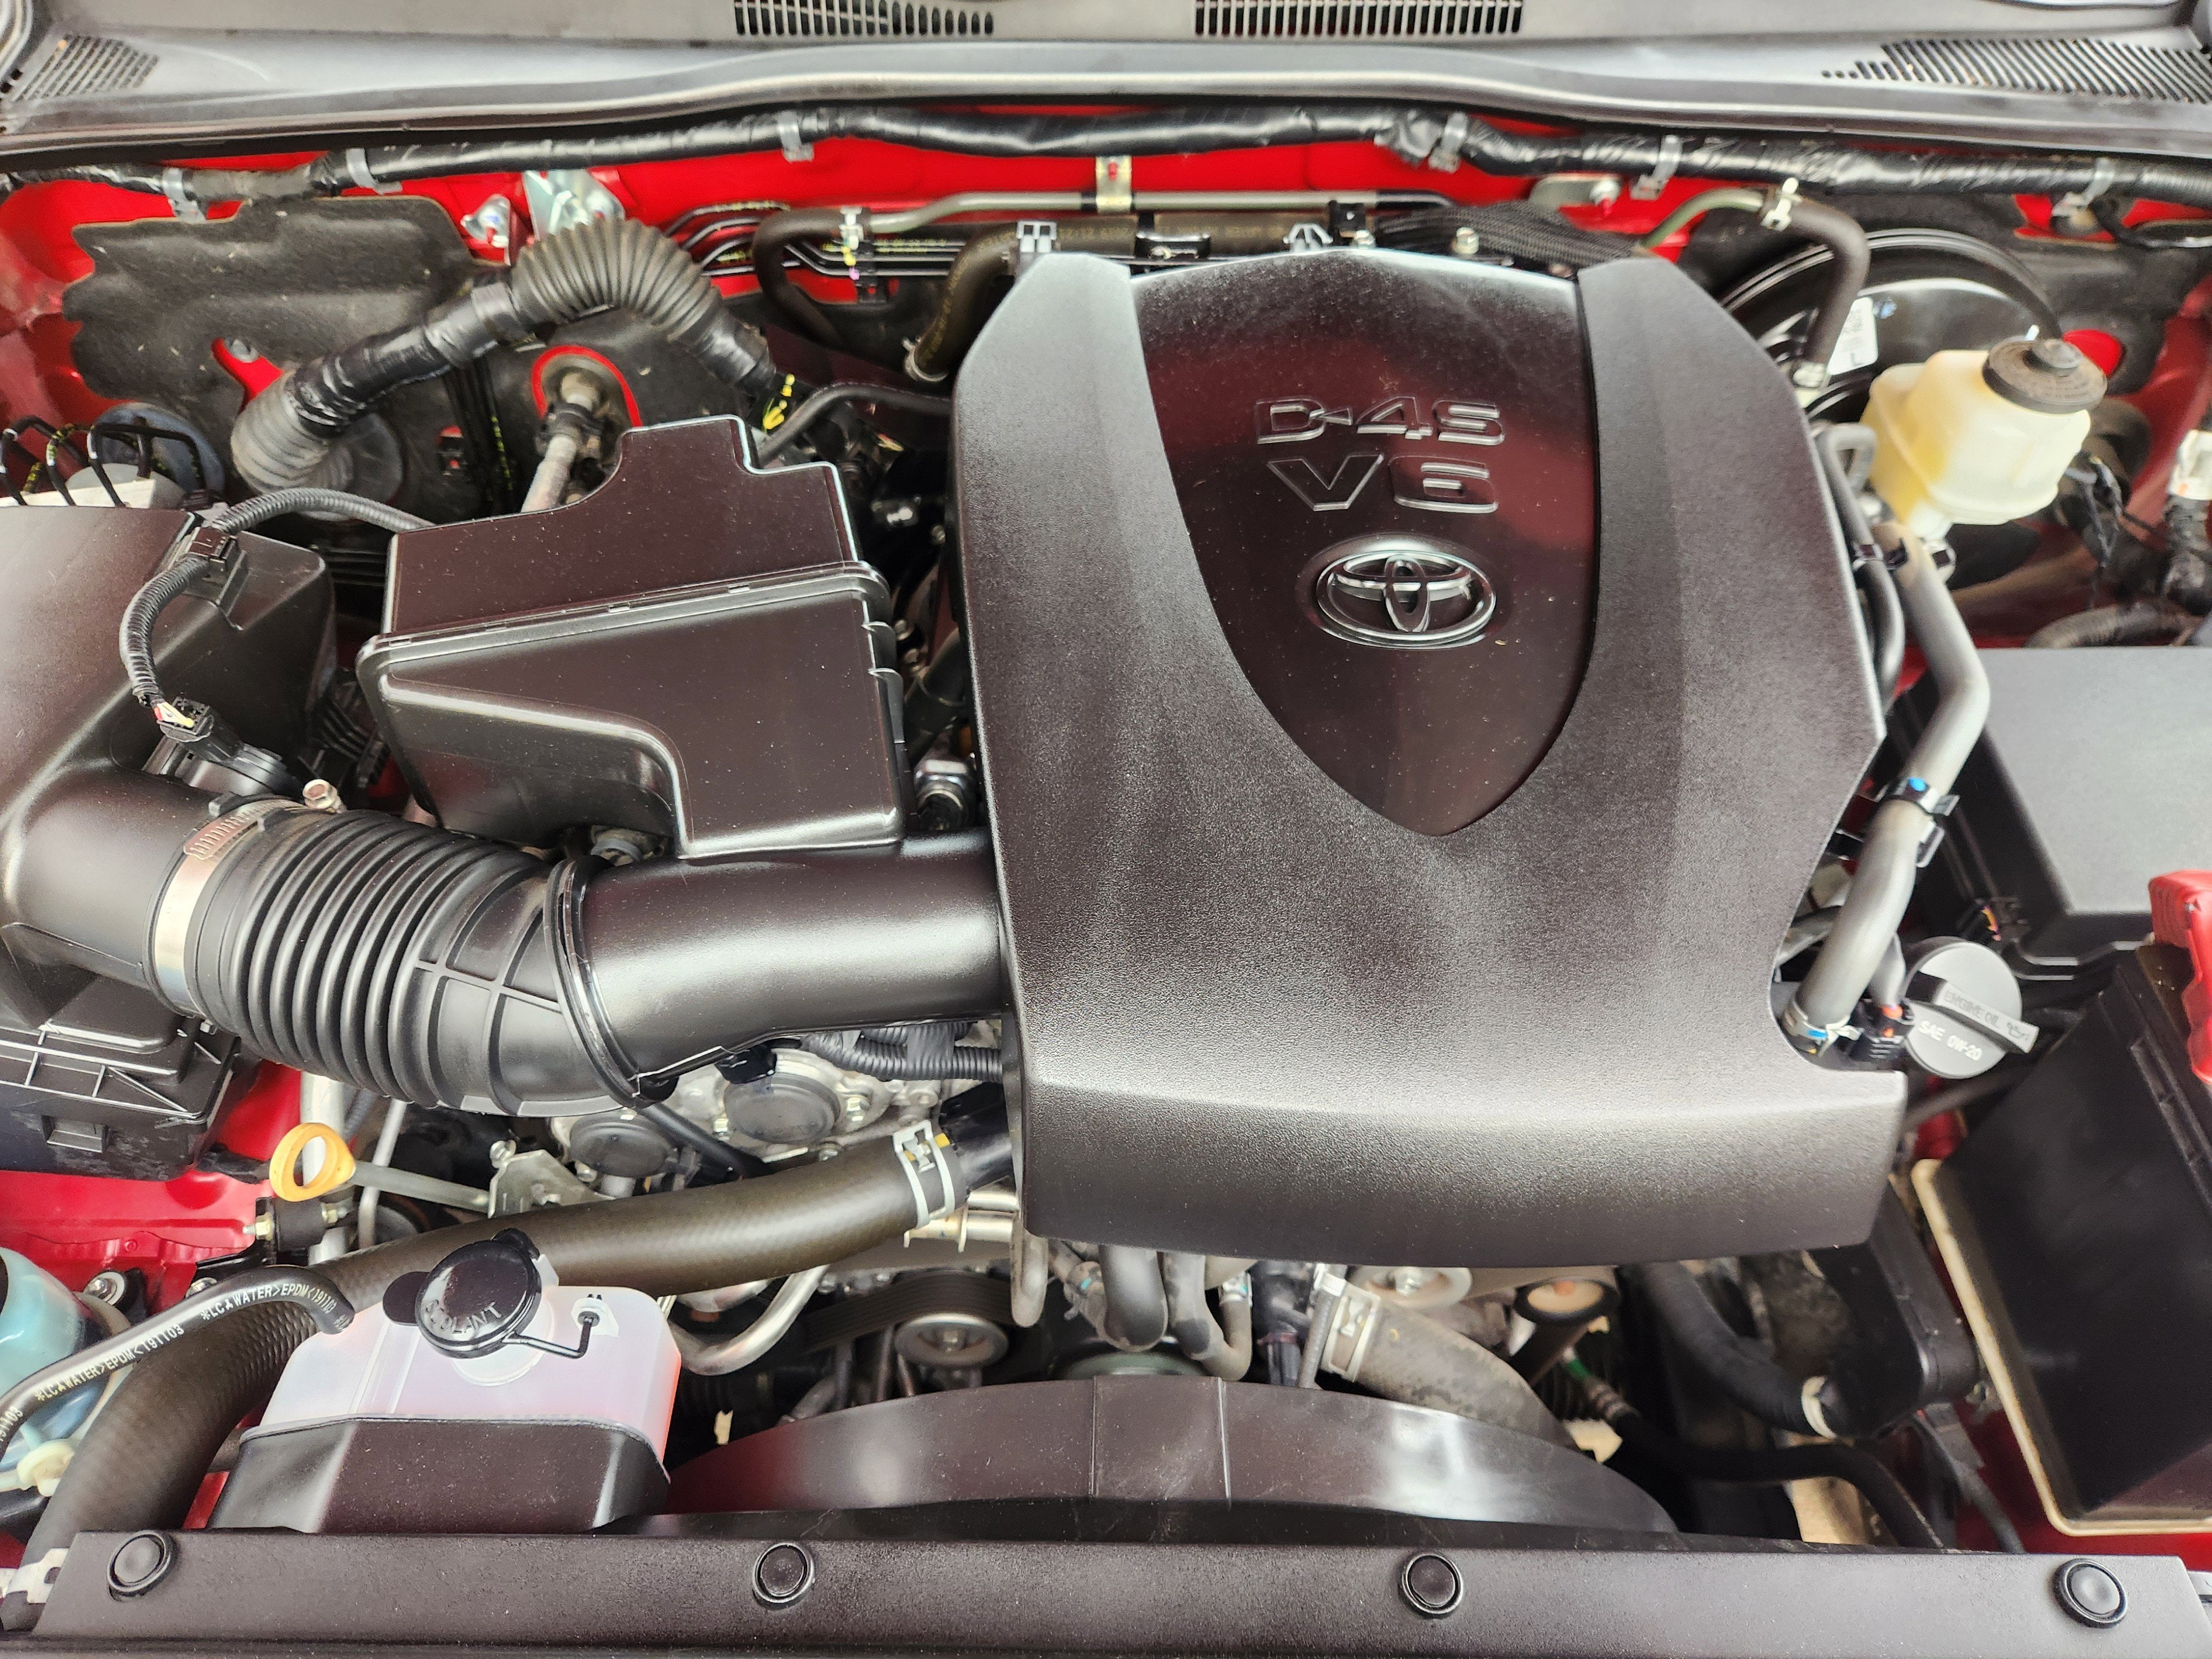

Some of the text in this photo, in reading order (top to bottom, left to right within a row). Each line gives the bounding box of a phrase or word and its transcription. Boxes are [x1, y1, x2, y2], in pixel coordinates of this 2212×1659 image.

[1255, 395, 1505, 446] D-4S
[1265, 452, 1499, 514] V6
[1944, 990, 2001, 1029] ENGINE OIL
[1918, 1020, 1946, 1041] SAE
[425, 1299, 503, 1334] COOLANT
